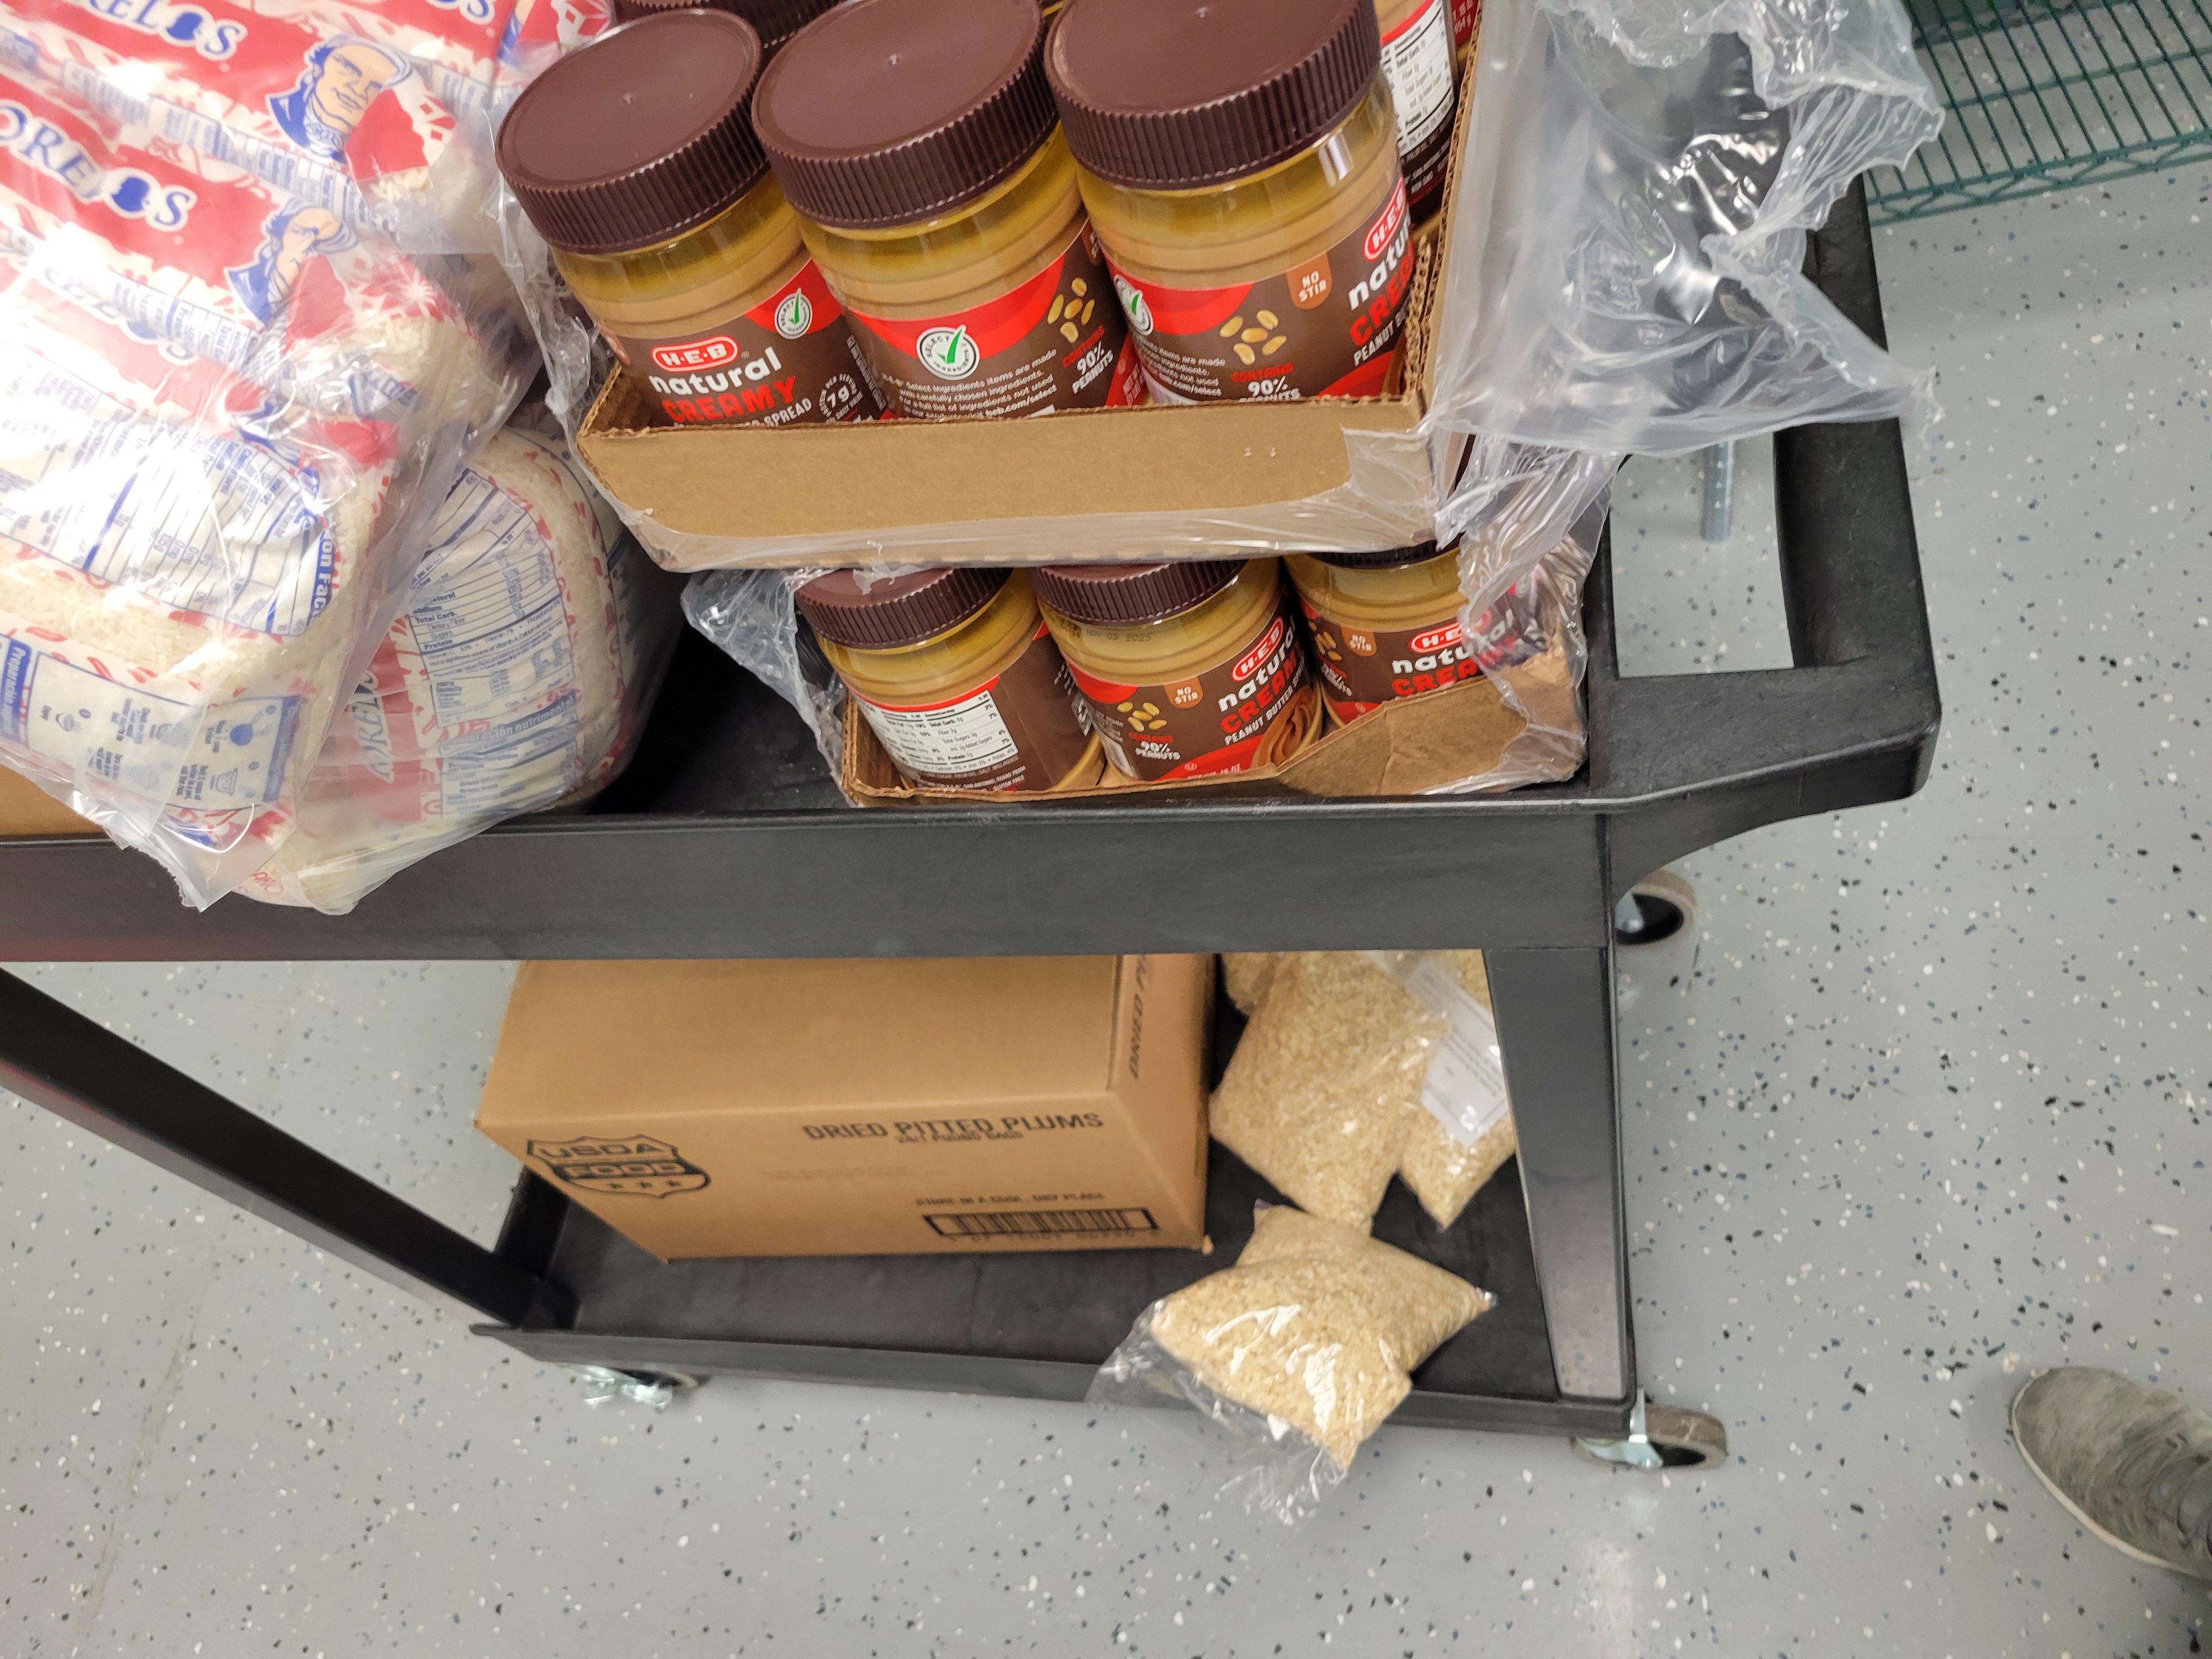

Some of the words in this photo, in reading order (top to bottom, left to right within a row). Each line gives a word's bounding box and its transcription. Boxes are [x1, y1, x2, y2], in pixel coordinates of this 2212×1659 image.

[1299, 279, 1327, 302] STIR
[1302, 270, 1319, 289] NO
[1353, 320, 1394, 366] PEANUT
[648, 346, 783, 396] natural
[1032, 348, 1057, 369] made
[1076, 340, 1105, 375] 90%
[1071, 349, 1114, 394] PEANUTS
[662, 375, 796, 423] CREAMY
[826, 385, 850, 408] 7g
[1248, 376, 1288, 397] 90%
[764, 398, 812, 427] SPREAD
[1125, 633, 1153, 642] 2025
[1217, 614, 1295, 713] natural
[1175, 692, 1199, 704] STIR
[1176, 686, 1192, 696] NO
[1220, 640, 1301, 733] CREAM
[1224, 715, 1264, 746] PEANUT
[1265, 684, 1294, 721] BUTTER
[803, 1122, 889, 1139] DRIED
[894, 1118, 995, 1136] PITTED
[1001, 1112, 1105, 1131] PLUMS
[539, 1143, 667, 1158] USDA
